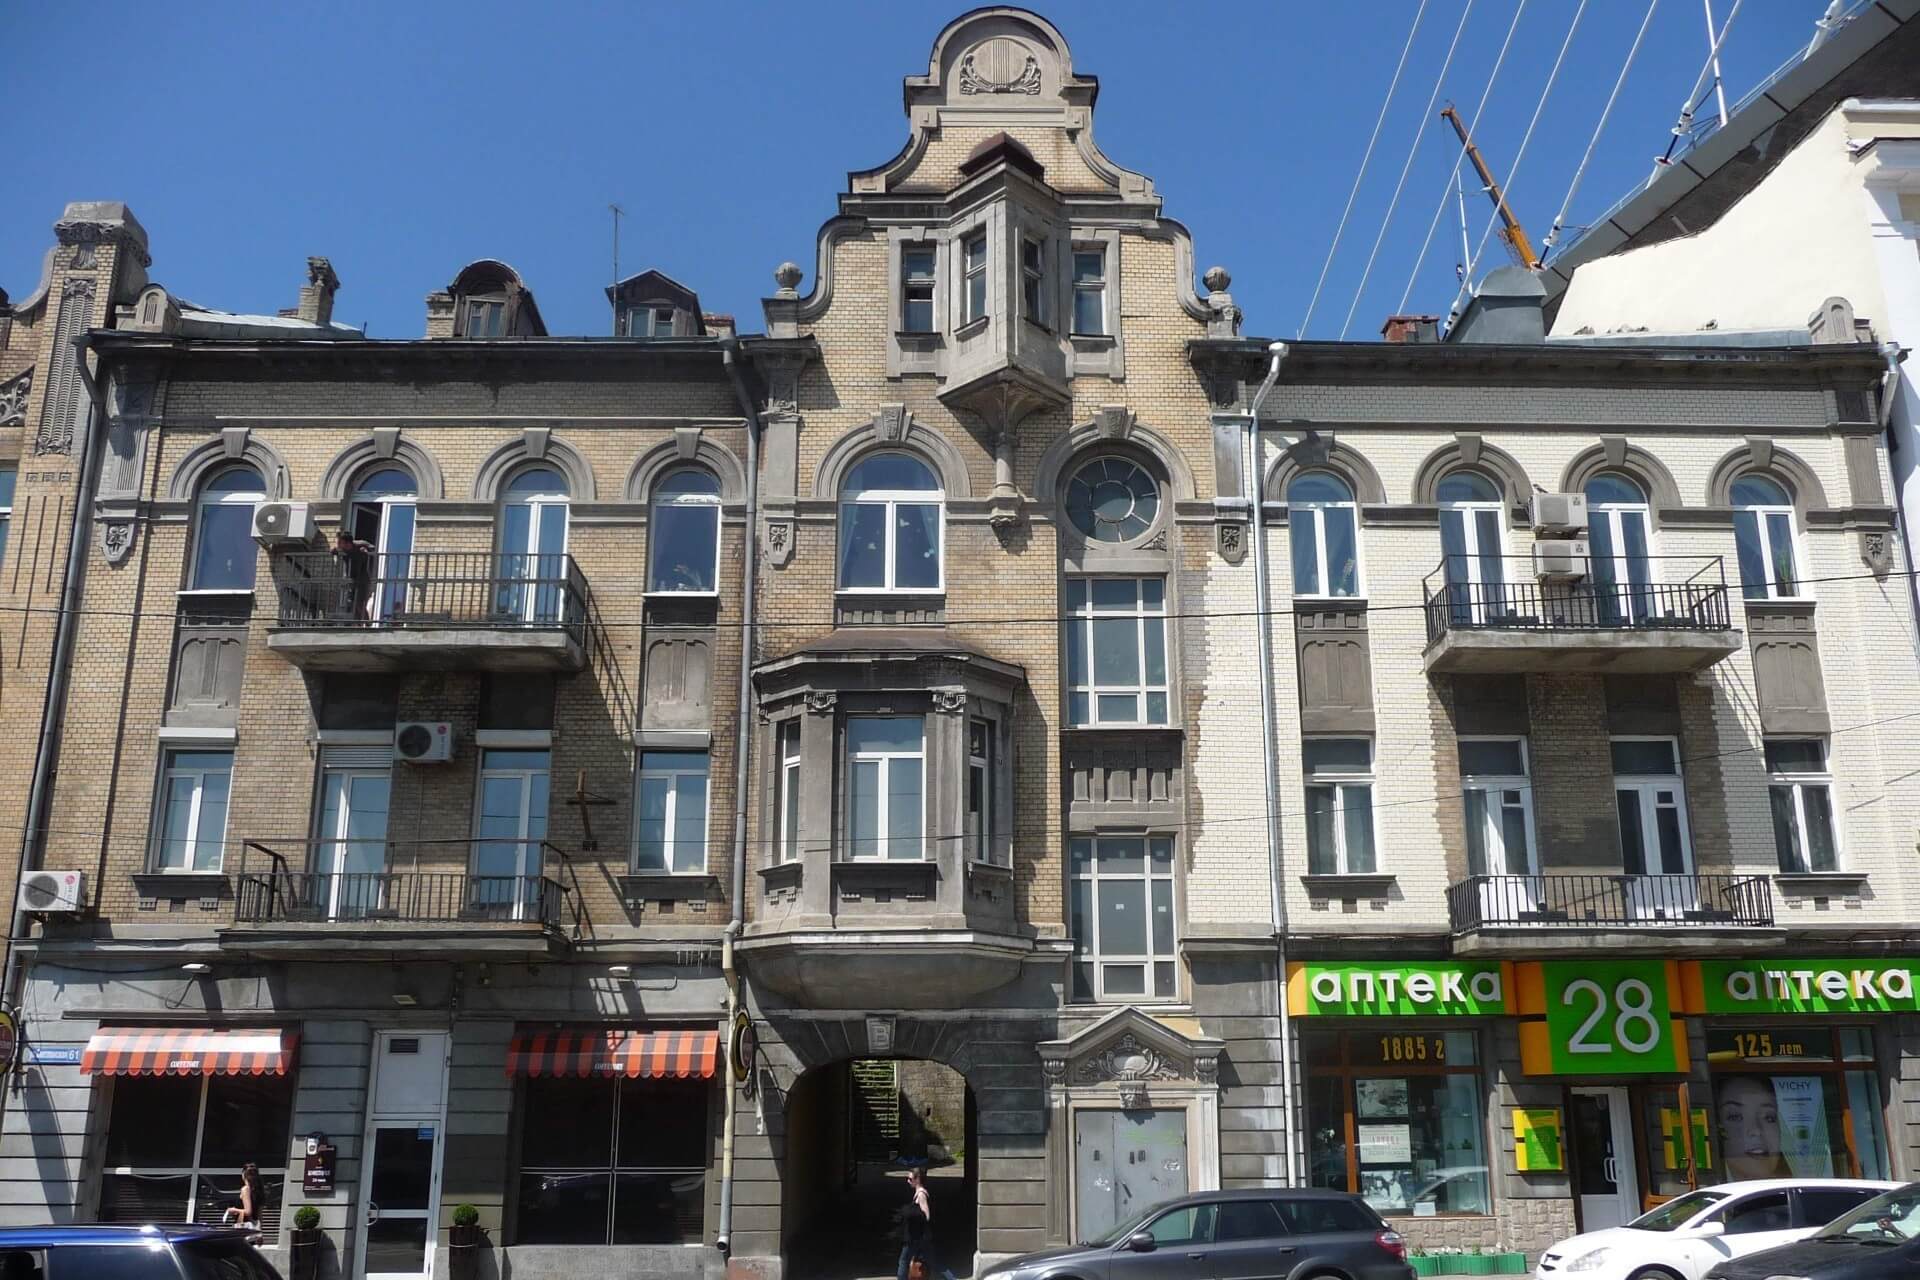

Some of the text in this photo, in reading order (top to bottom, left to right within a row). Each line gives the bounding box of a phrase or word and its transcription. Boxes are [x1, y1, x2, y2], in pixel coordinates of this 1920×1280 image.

[1311, 971, 1501, 1003] аптека
[1727, 968, 1913, 1001] аптека
[1563, 978, 1660, 1053] 28
[68, 1049, 80, 1061] 61
[1380, 1036, 1427, 1061] 1885
[1734, 1033, 1804, 1058] 125 лет
[1778, 1080, 1812, 1090] VICHY
